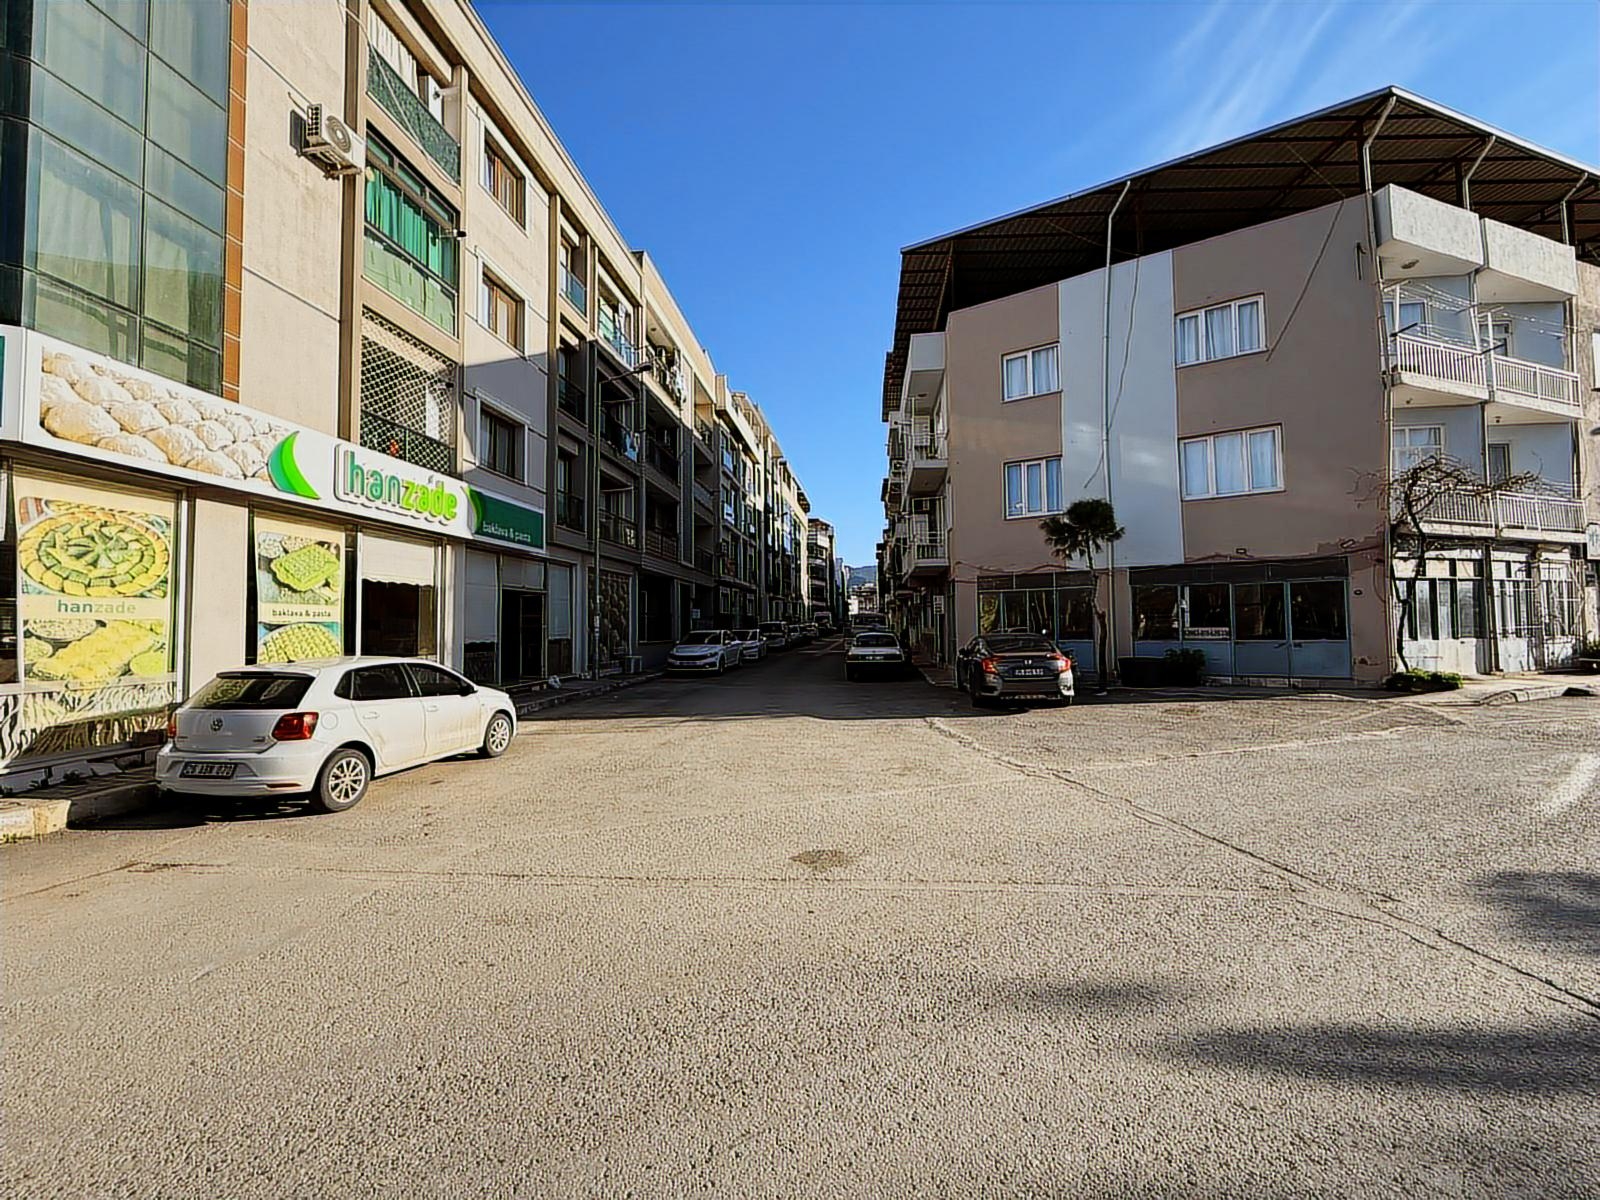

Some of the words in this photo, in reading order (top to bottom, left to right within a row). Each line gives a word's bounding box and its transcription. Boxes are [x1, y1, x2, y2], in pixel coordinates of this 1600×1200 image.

[345, 450, 458, 520] hanzade
[482, 520, 508, 537] baklava
[515, 532, 531, 543] pasta
[57, 599, 136, 614] hanzade
[272, 608, 303, 617] baklava
[305, 609, 311, 617] &
[312, 610, 331, 618] pasta
